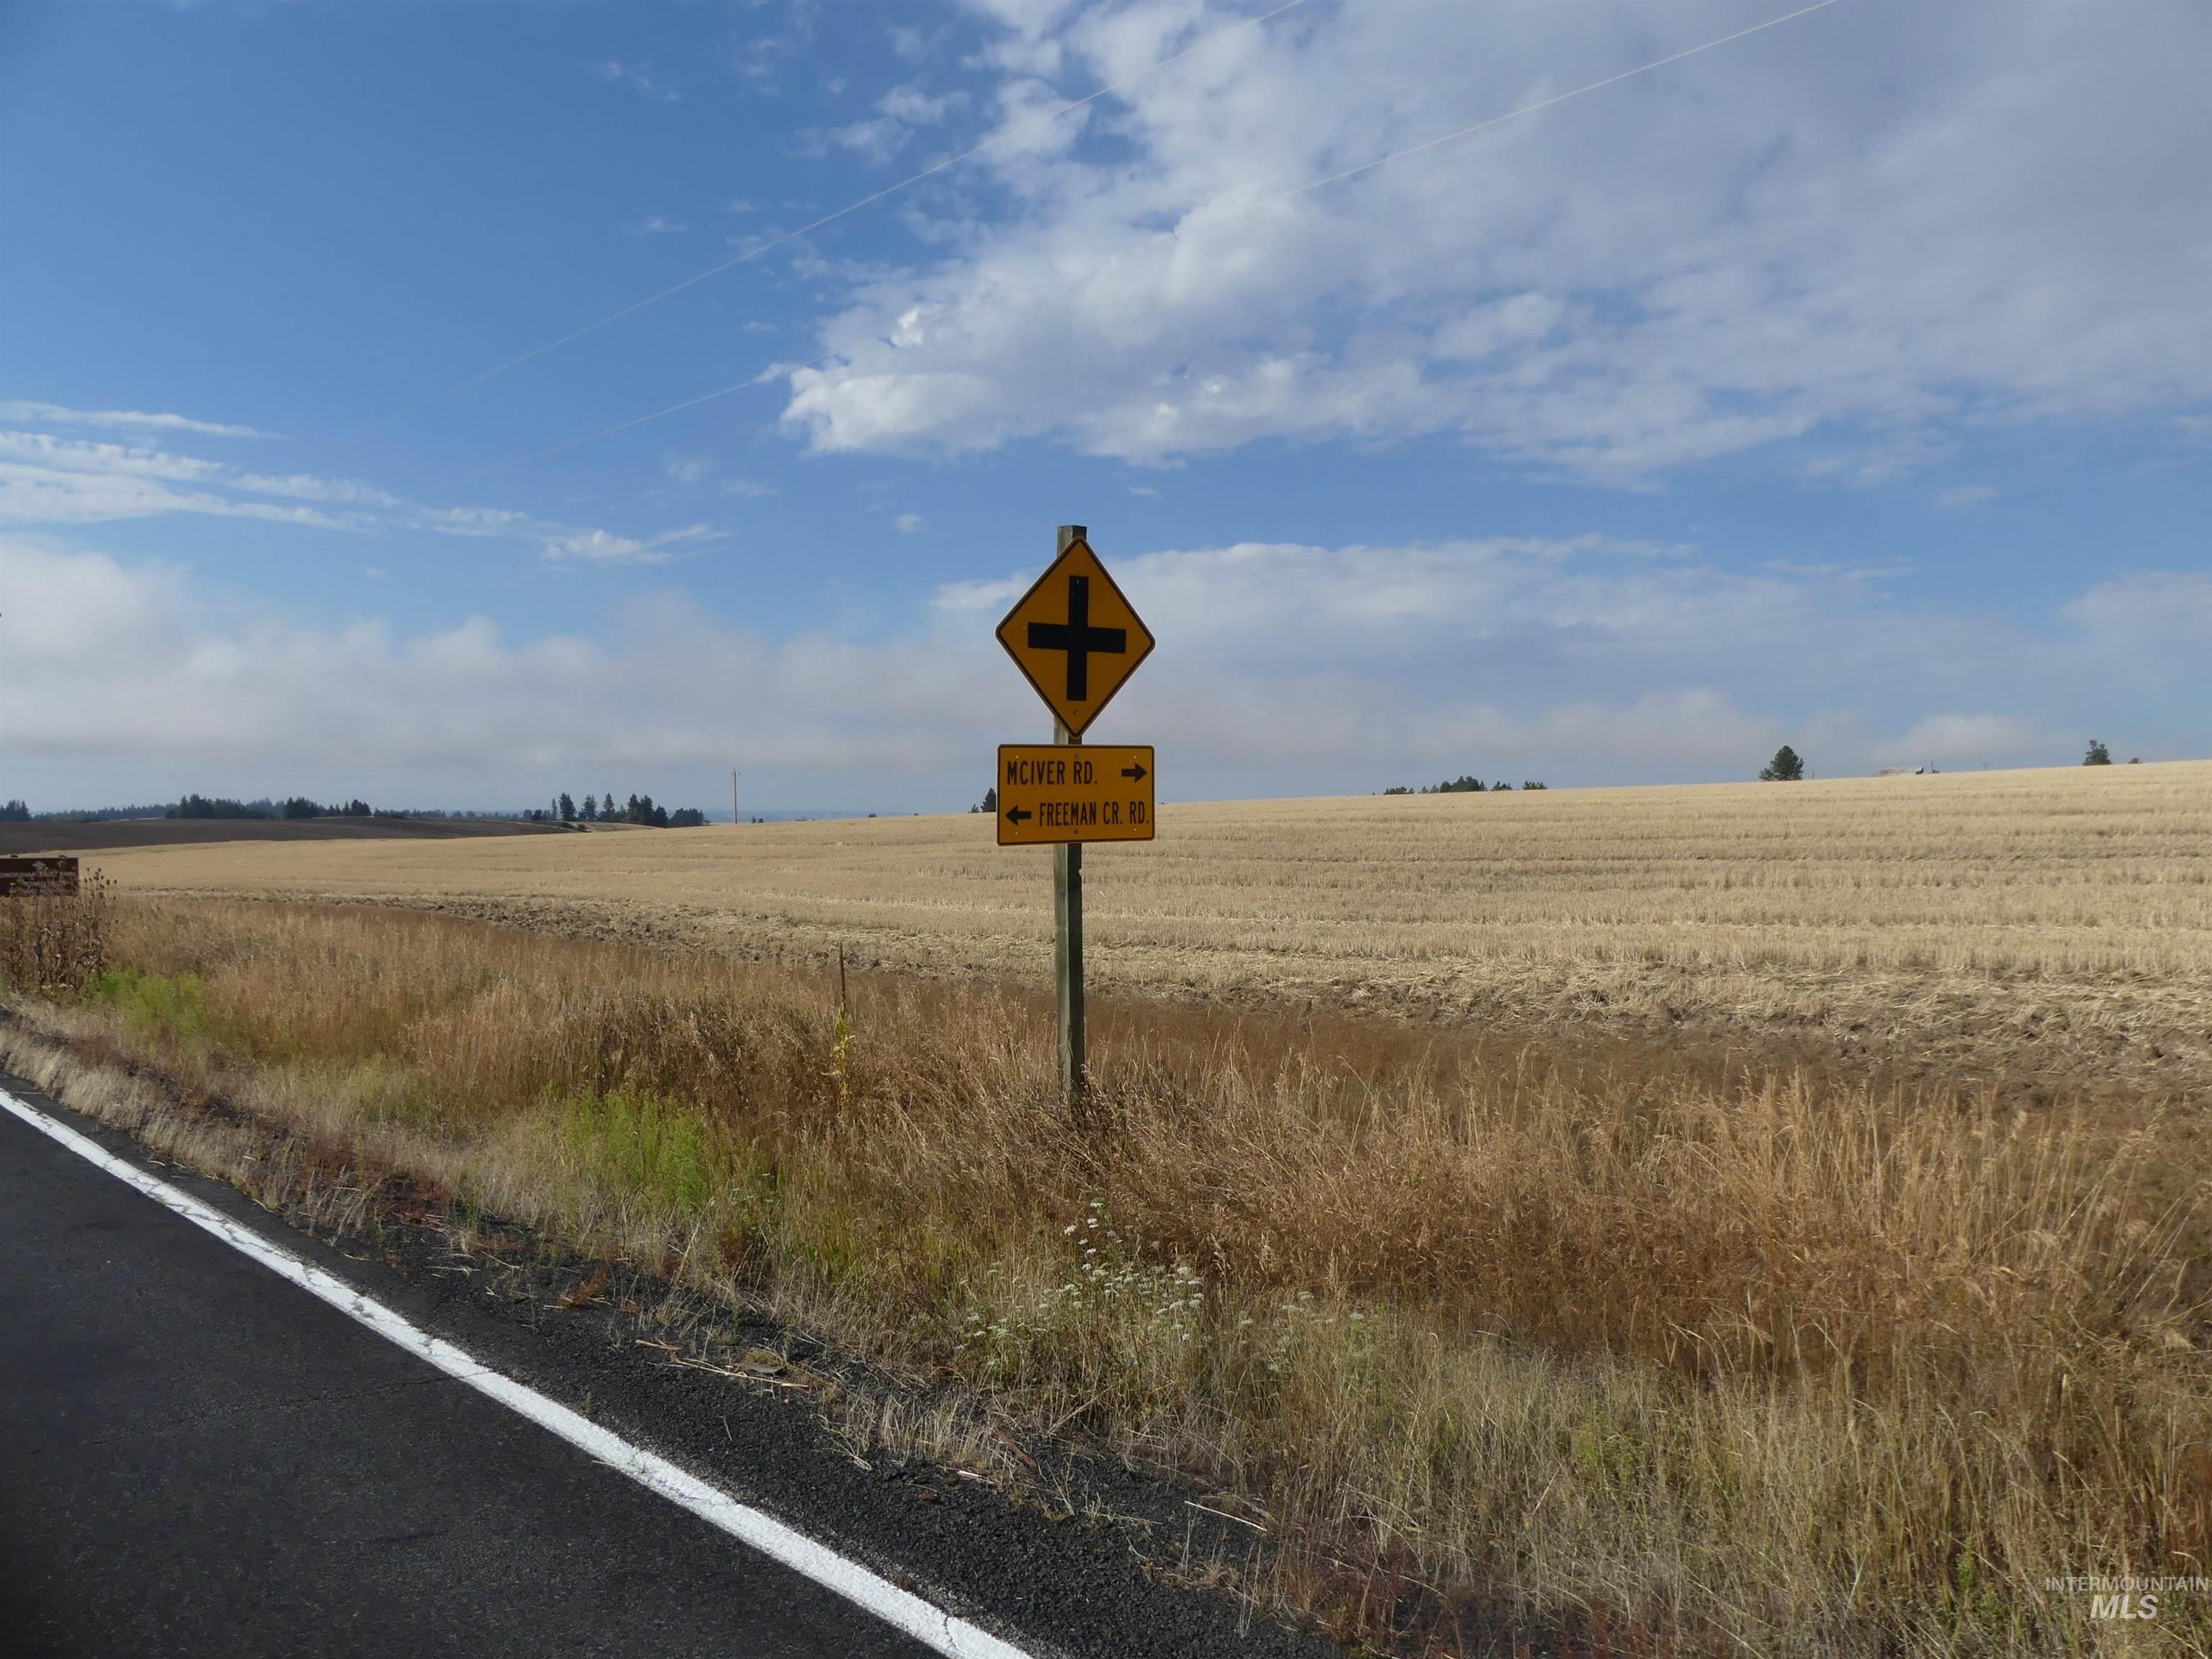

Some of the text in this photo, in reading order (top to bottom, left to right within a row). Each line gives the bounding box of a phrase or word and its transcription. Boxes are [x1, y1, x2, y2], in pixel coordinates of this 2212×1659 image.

[1007, 760, 1098, 785] MCIVER RD.
[1039, 801, 1149, 827] FREEMAN CR. RD.
